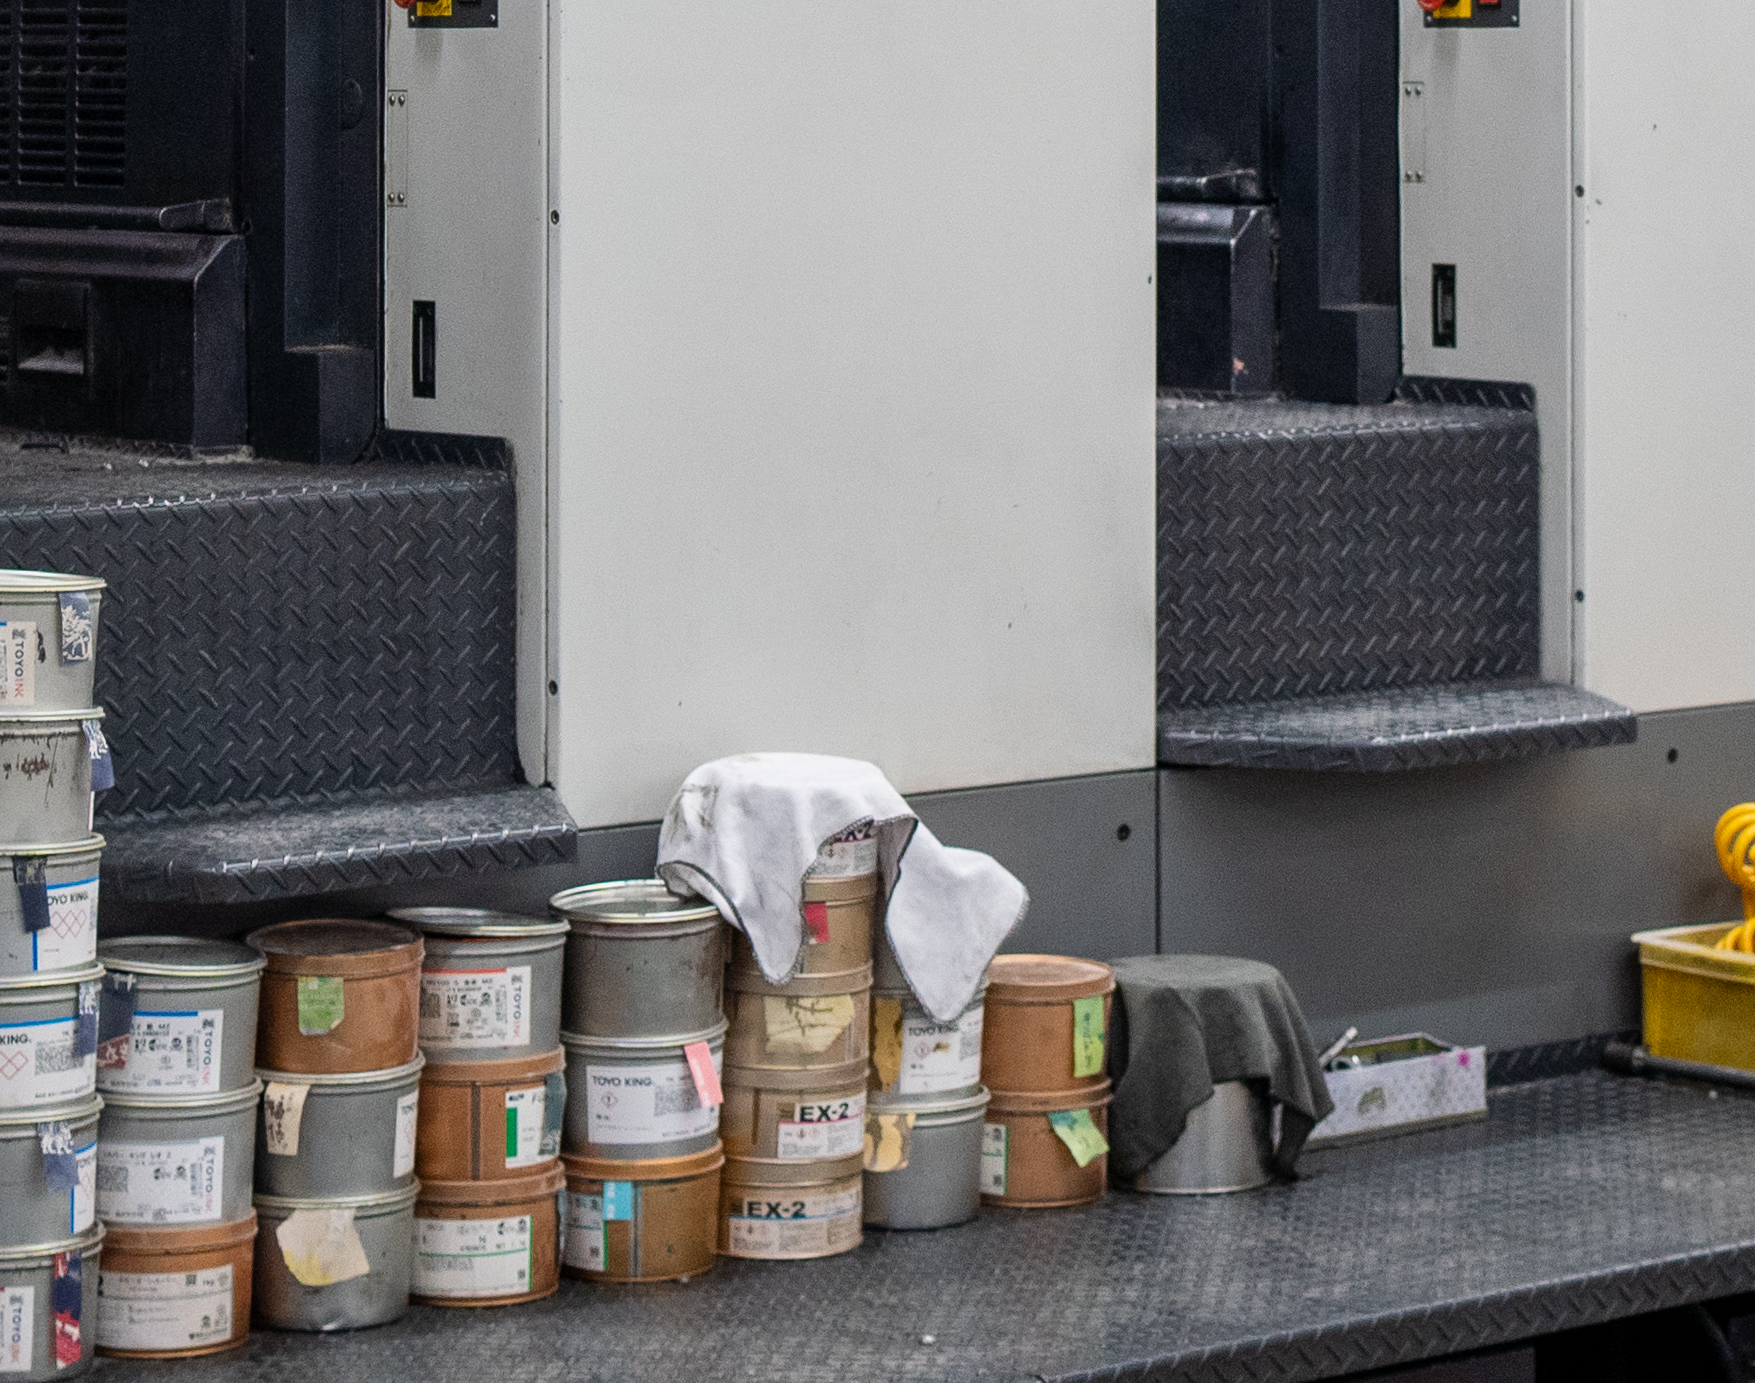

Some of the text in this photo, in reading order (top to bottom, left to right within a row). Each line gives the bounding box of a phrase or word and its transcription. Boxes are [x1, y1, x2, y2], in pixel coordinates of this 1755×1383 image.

[47, 894, 68, 905] OYO
[800, 1103, 849, 1122] EX-2
[747, 1201, 806, 1219] EX-2
